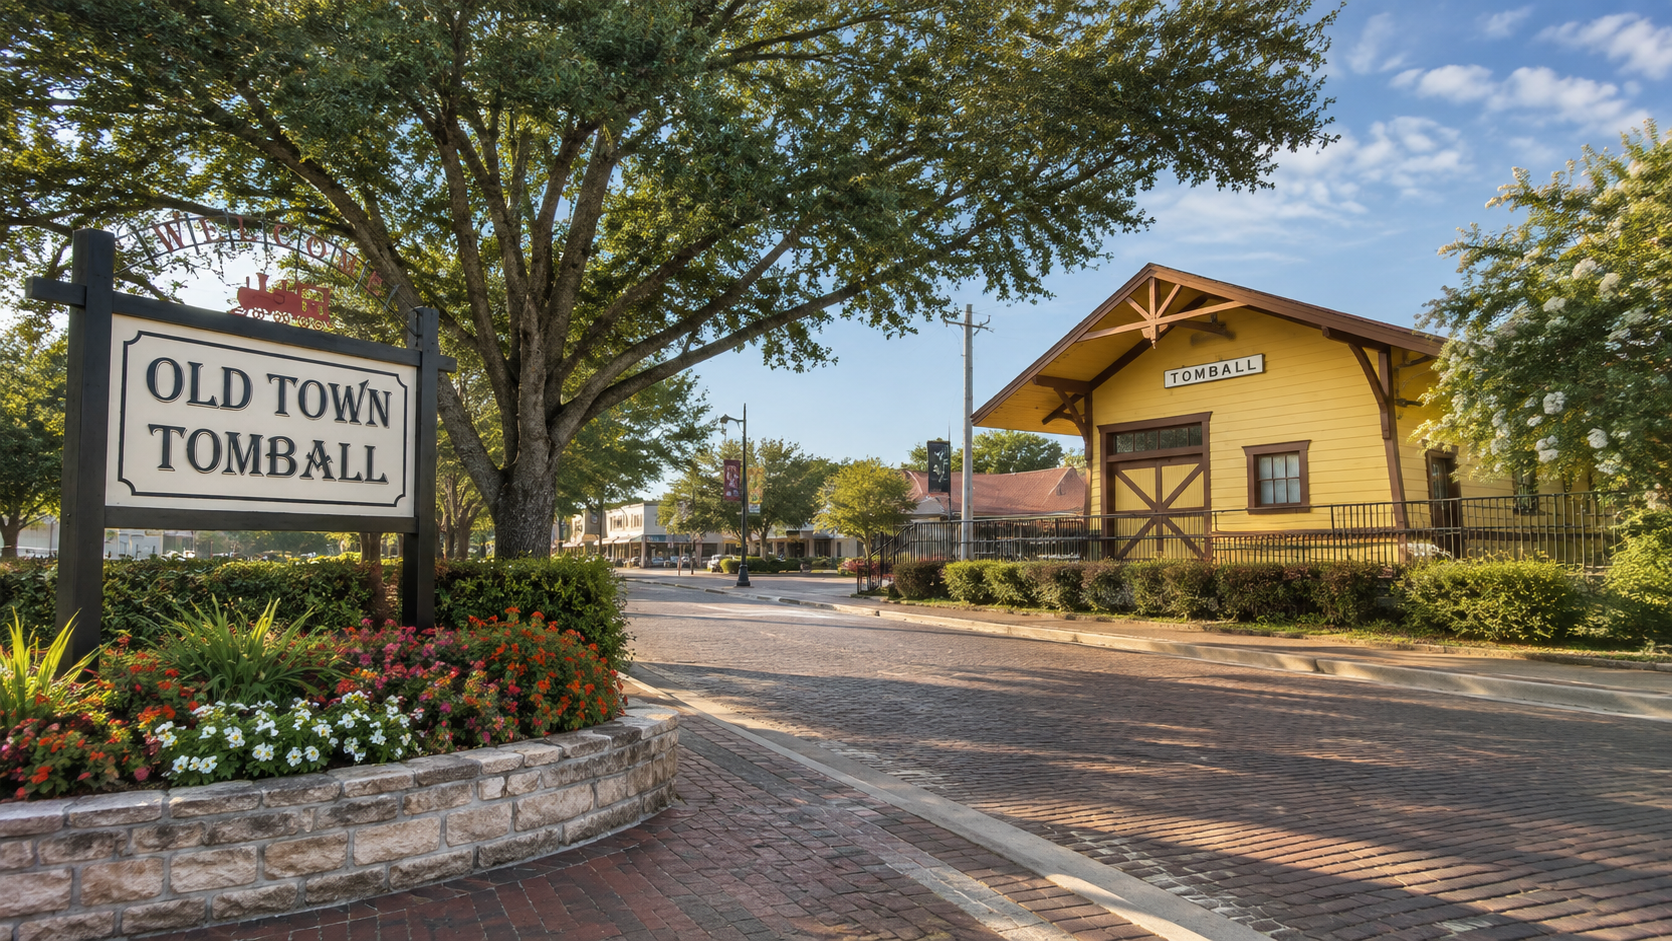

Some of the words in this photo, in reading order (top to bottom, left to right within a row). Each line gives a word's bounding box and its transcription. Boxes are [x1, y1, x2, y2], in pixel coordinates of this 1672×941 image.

[153, 215, 383, 296] WELCOME
[146, 357, 253, 411] OLD
[266, 373, 392, 428] TOWN
[1170, 359, 1257, 384] TOMBALL
[147, 423, 389, 485] TOMBALL
